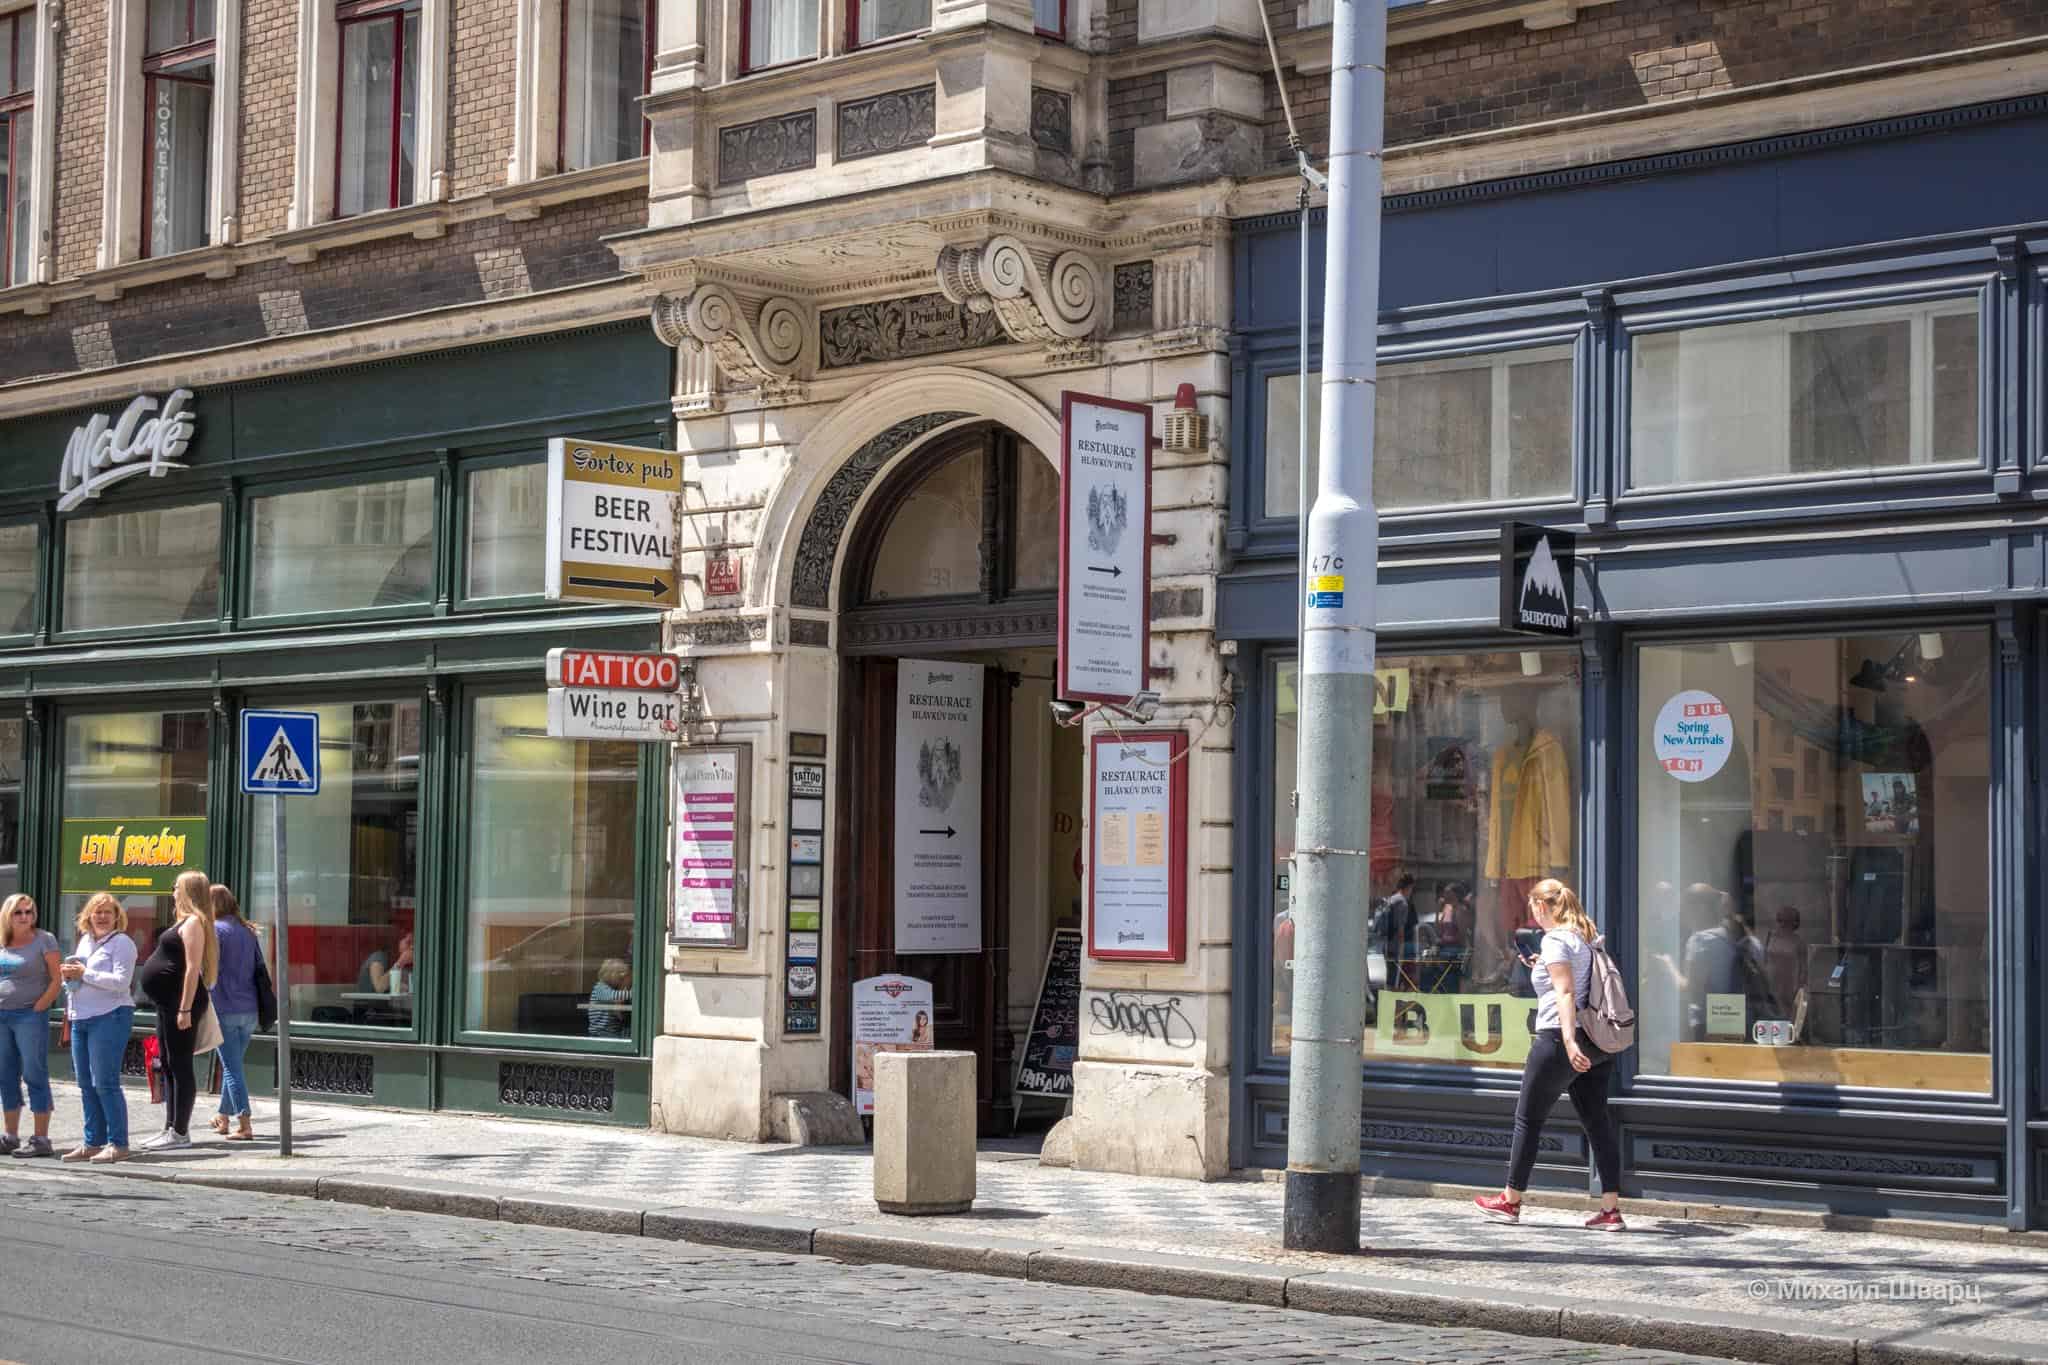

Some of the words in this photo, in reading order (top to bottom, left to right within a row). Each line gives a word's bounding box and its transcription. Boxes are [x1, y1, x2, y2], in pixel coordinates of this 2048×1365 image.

[59, 389, 197, 499] McCafé
[1078, 439, 1136, 459] RESTAURACE
[642, 459, 673, 484] pub
[595, 495, 651, 522] BEER
[570, 527, 673, 558] FESTIVAL
[1520, 609, 1568, 629] BURTON
[564, 653, 678, 687] TATTOO
[569, 693, 627, 720] Wine
[637, 696, 674, 721] bar
[908, 694, 972, 708] RESTAURACE
[1678, 720, 1710, 735] Spring
[1664, 734, 1684, 745] New
[1685, 734, 1724, 745] Arrivals
[794, 771, 821, 783] TATTOO
[1101, 770, 1166, 781] RESTAURACE
[79, 826, 125, 866] LETNÍ
[123, 827, 187, 867] BRIGÁDA
